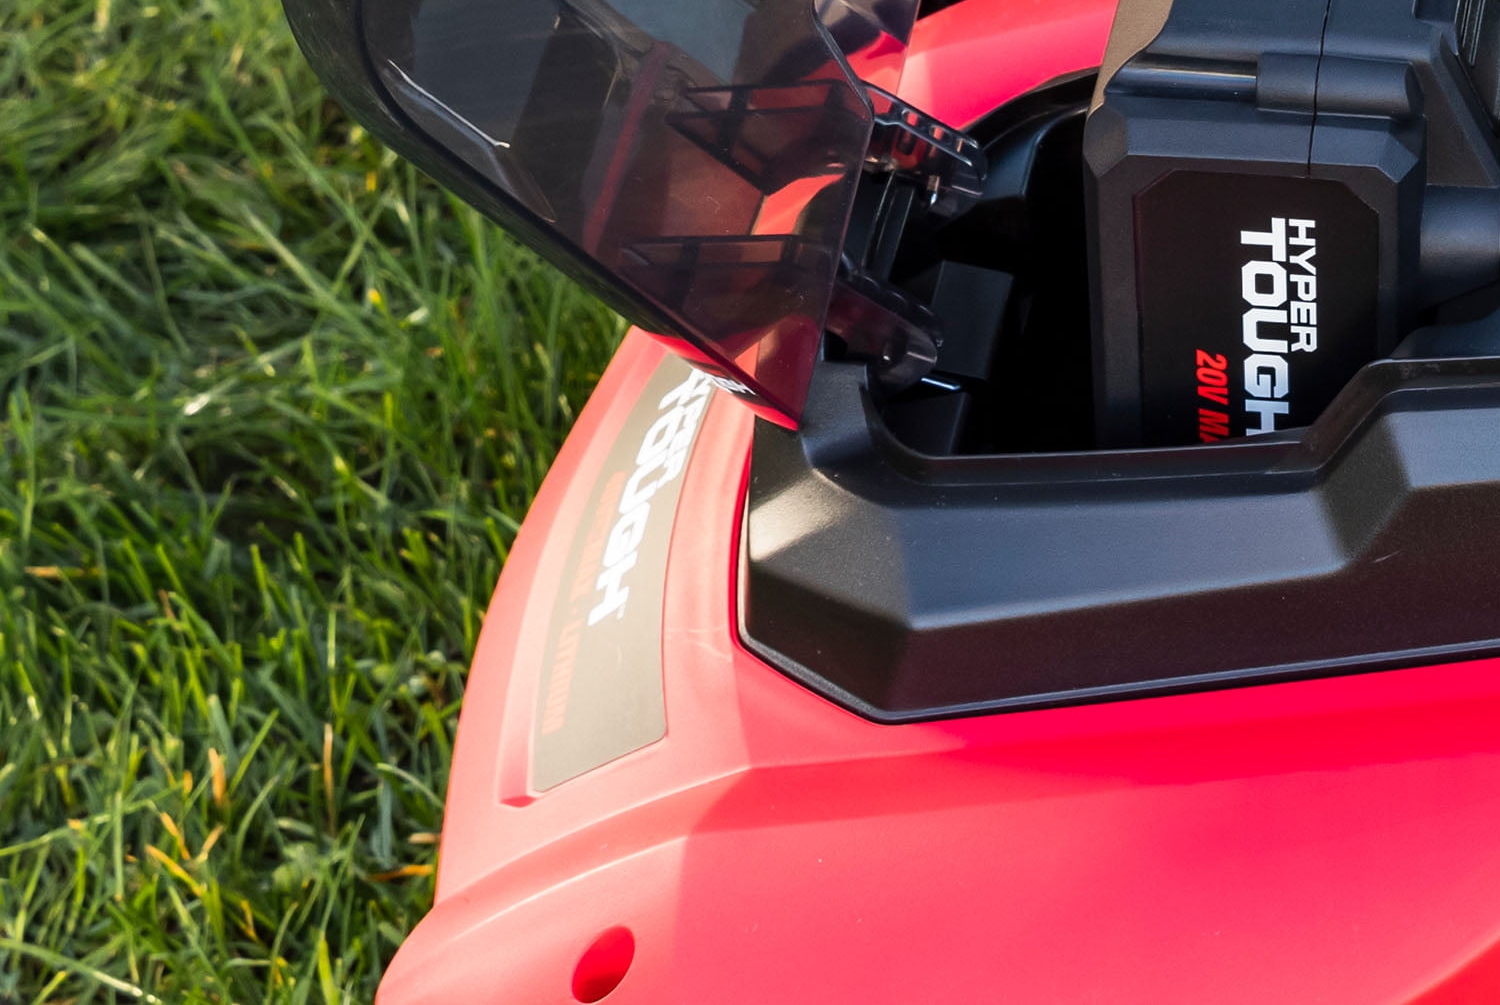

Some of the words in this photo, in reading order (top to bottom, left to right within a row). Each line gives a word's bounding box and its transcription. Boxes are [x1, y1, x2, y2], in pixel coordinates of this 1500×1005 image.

[1240, 217, 1289, 436] TOUGH
[1289, 219, 1318, 353] HYPER
[655, 372, 713, 491] YPER
[1196, 348, 1229, 406] 20V
